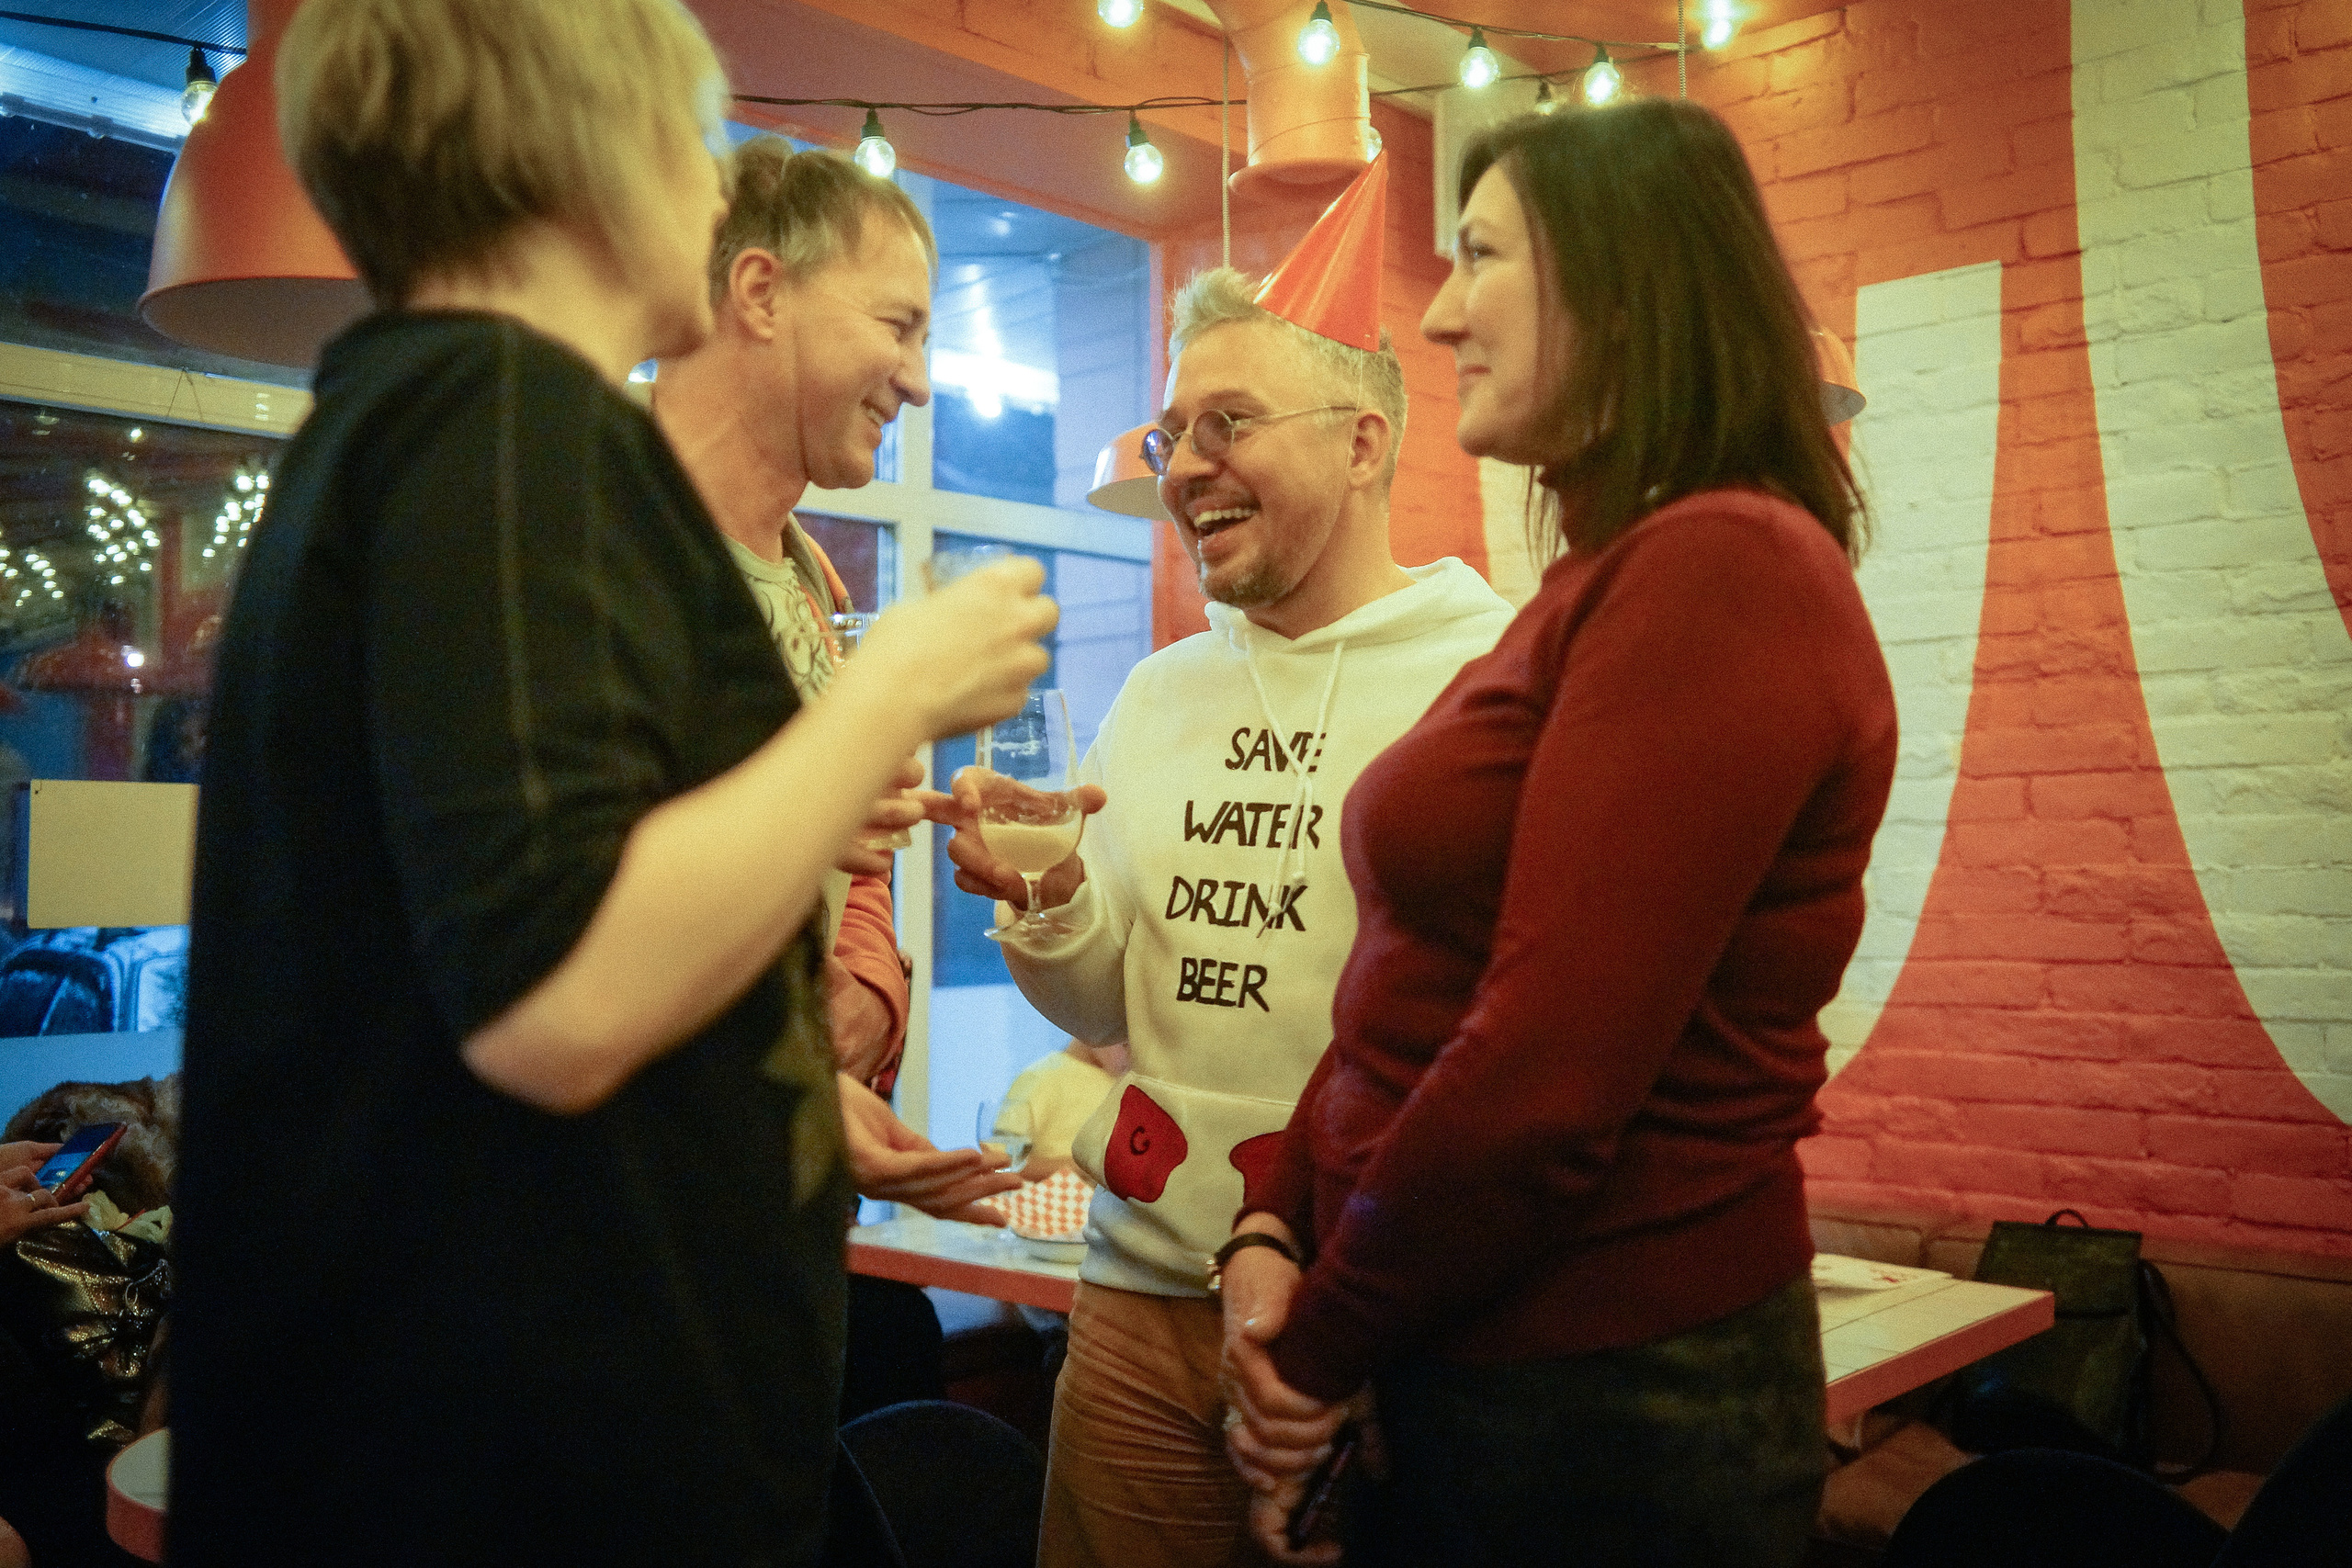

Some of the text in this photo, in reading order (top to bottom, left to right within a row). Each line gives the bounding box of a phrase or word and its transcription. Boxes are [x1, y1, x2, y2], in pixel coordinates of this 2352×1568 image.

[1225, 727, 1327, 773] SAVE
[1184, 800, 1324, 850] WATER
[1165, 875, 1308, 931] DRINK
[1176, 956, 1270, 1012] BEER
